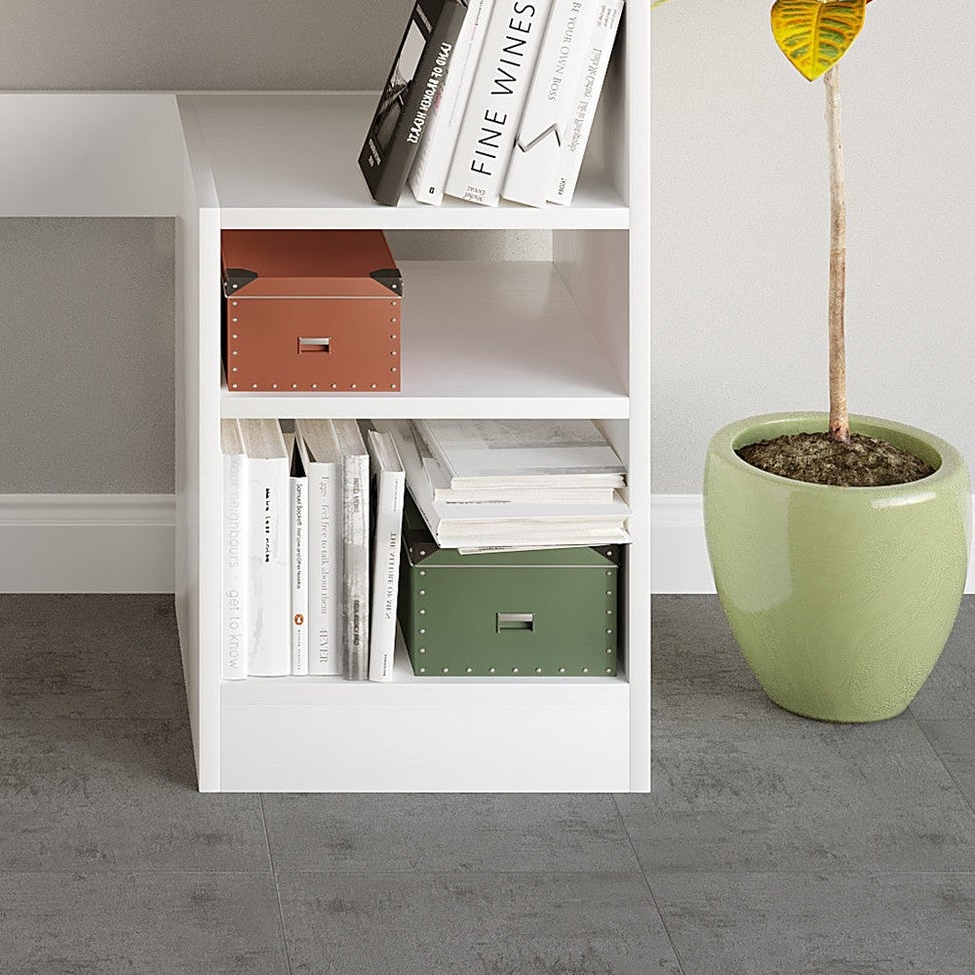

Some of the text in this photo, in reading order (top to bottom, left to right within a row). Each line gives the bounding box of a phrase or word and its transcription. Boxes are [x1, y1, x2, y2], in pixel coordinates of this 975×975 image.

[547, 2, 582, 101] BE YOUR OWN BOSS
[470, 0, 537, 176] FINE WINES
[320, 504, 330, 520] feel
[320, 521, 330, 538] free
[320, 539, 329, 548] to
[226, 589, 241, 611] get
[229, 616, 240, 630] to
[229, 634, 241, 670] know
